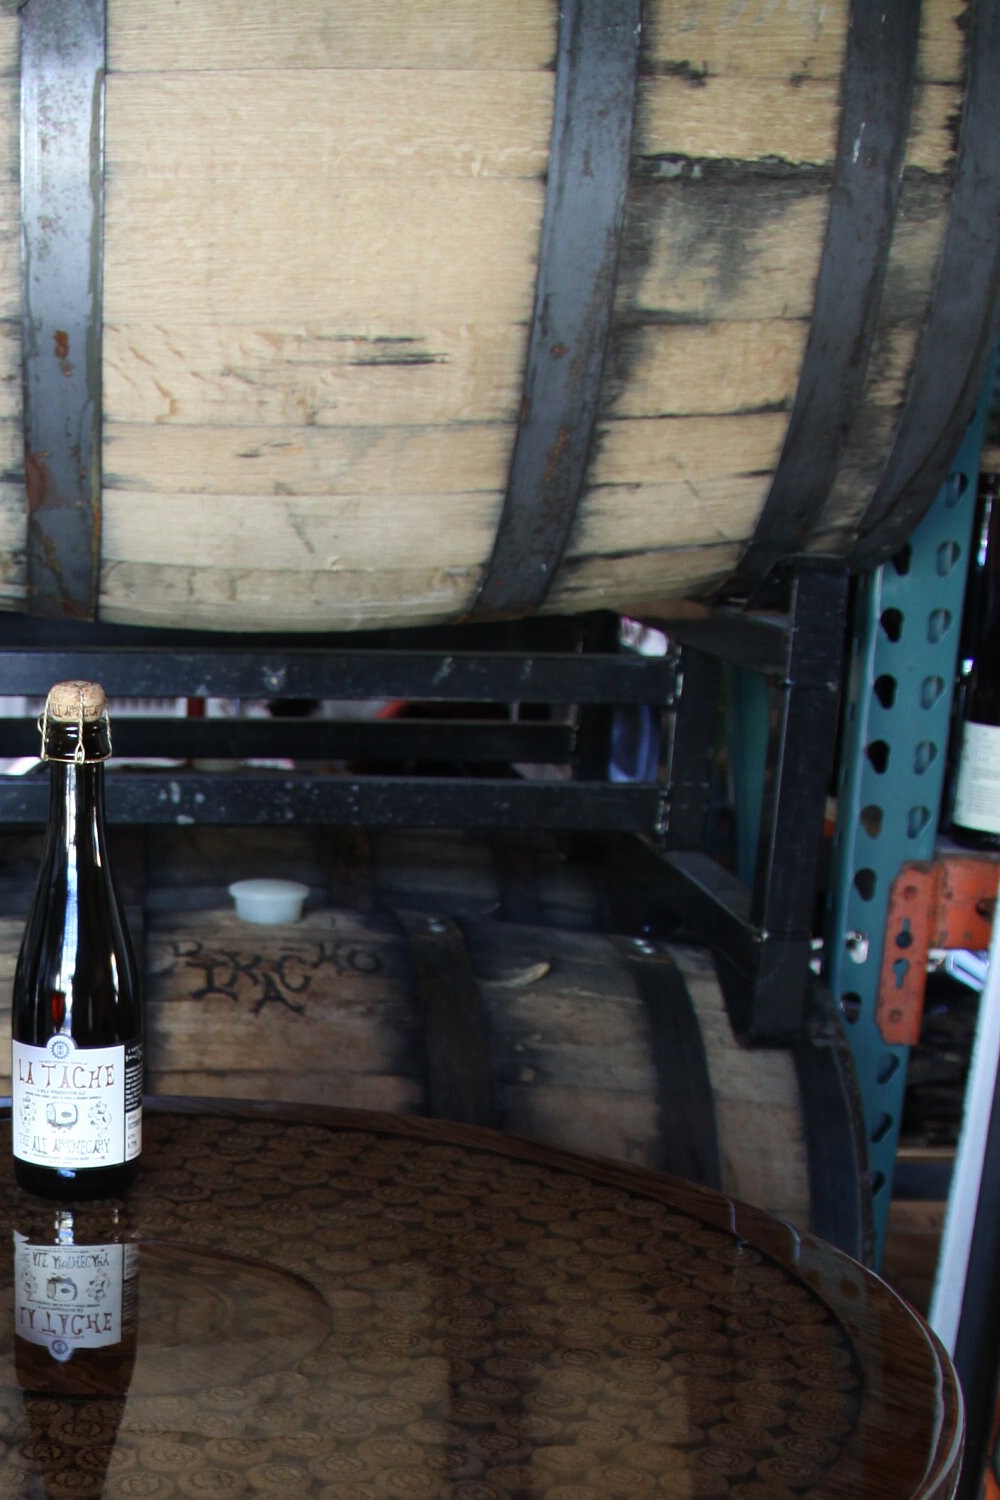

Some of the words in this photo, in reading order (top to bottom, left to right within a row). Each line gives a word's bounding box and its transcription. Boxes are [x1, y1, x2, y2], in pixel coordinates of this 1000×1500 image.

[18, 1058, 36, 1086] LA
[41, 1064, 115, 1089] TACHE
[32, 1135, 48, 1154] ALE
